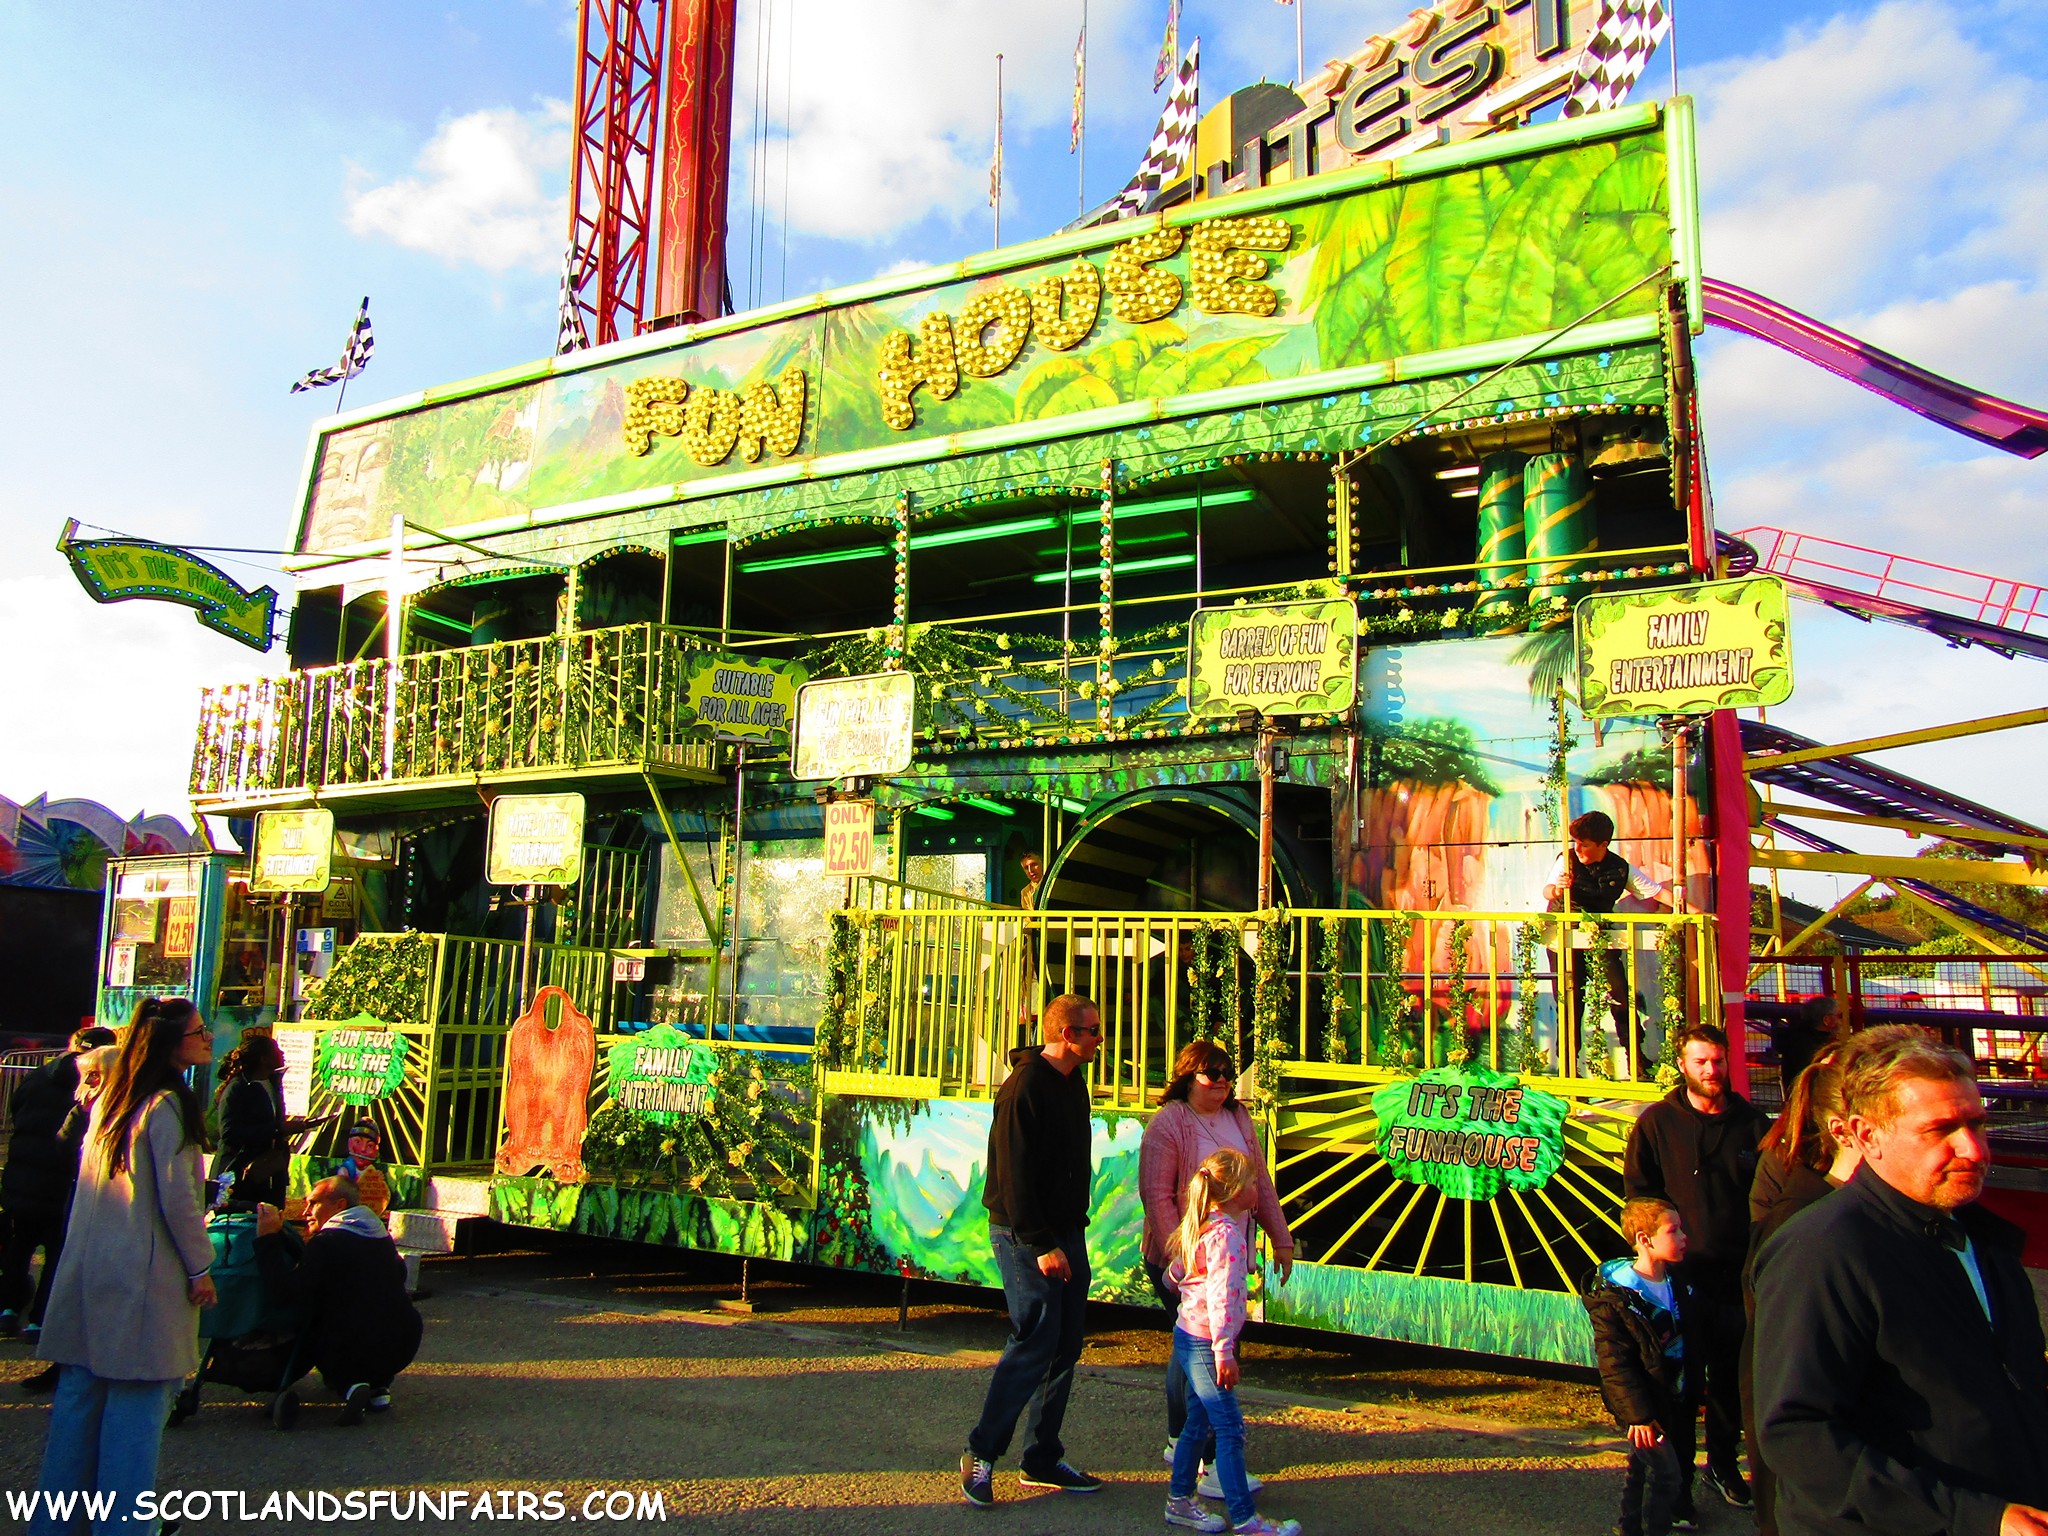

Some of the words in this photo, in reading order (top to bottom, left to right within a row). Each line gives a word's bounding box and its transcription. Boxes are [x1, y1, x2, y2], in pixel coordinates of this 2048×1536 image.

[623, 364, 806, 468] FUN
[879, 217, 1293, 431] HOUSE
[96, 550, 138, 580] IT'S
[141, 556, 180, 584] THE
[187, 567, 253, 618] FUNHOUSE
[1220, 626, 1277, 659] BARRELS
[1279, 624, 1299, 656] OF
[1300, 621, 1328, 656] FUN
[1646, 610, 1710, 649] FAMILY
[713, 669, 776, 698] SUITABLE
[1223, 662, 1252, 697] FOR
[1252, 659, 1321, 696] EVERYONE
[1609, 647, 1753, 695] ENTERTAINMENT
[699, 696, 727, 724] FOR
[726, 699, 750, 724] ALL
[751, 703, 787, 728] AGES
[872, 695, 894, 723] ALL
[829, 806, 869, 825] ONLY
[829, 831, 870, 871] £2.50
[171, 904, 196, 917] ONLY
[882, 918, 899, 929] WAY
[168, 922, 194, 953] £2.50
[617, 961, 641, 975] OUT
[330, 1029, 362, 1048] FUN
[364, 1030, 396, 1050] FOR
[330, 1051, 358, 1072] ALL
[360, 1052, 391, 1074] THE
[633, 1046, 693, 1079] FAMILY
[330, 1073, 386, 1097] FAMILY
[618, 1079, 709, 1114] ENTERTAINMENT
[1406, 1083, 1463, 1119] IT'S
[1467, 1085, 1524, 1124] THE
[1388, 1125, 1541, 1172] FUNHOUSE
